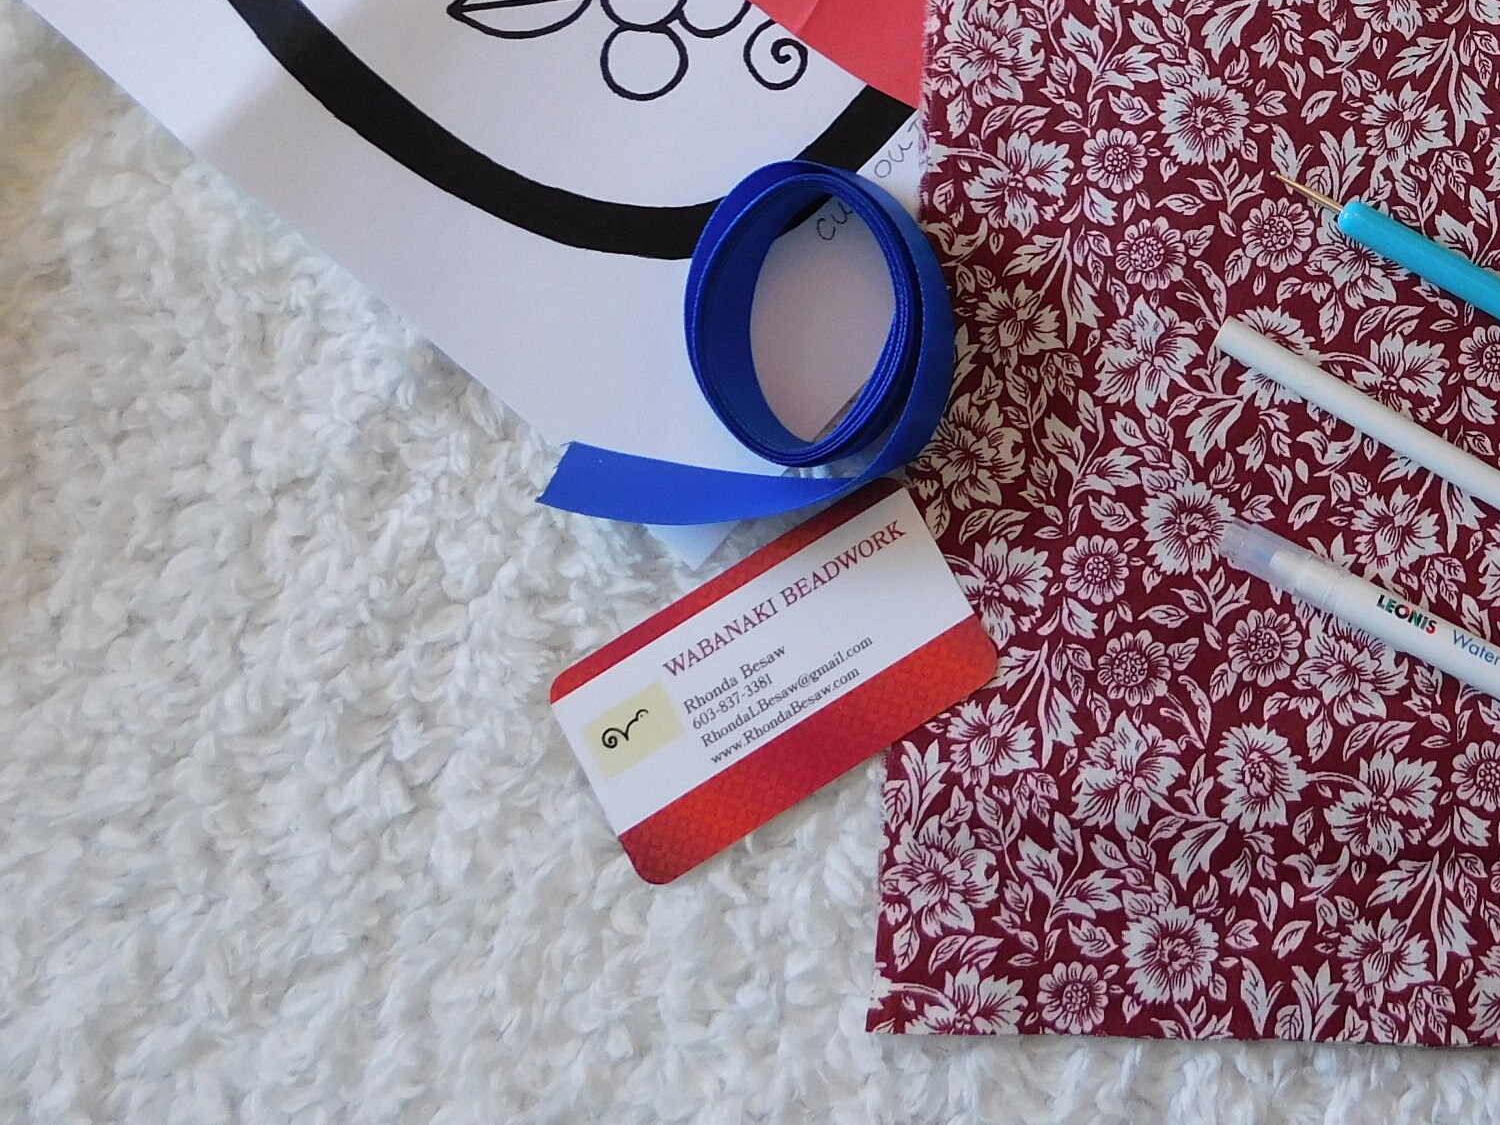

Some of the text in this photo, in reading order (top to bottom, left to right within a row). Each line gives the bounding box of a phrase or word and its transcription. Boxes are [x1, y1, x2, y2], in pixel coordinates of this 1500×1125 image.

[662, 519, 906, 677] WABANAKI BEADWORK
[1376, 594, 1438, 634] LEONIS
[682, 644, 787, 715] Rhonda Besaw
[692, 673, 773, 730] 603-837-3381
[700, 635, 873, 748] RhondaLBesaw@gmail.com
[710, 667, 860, 764] www.RhondaBesaw.com
